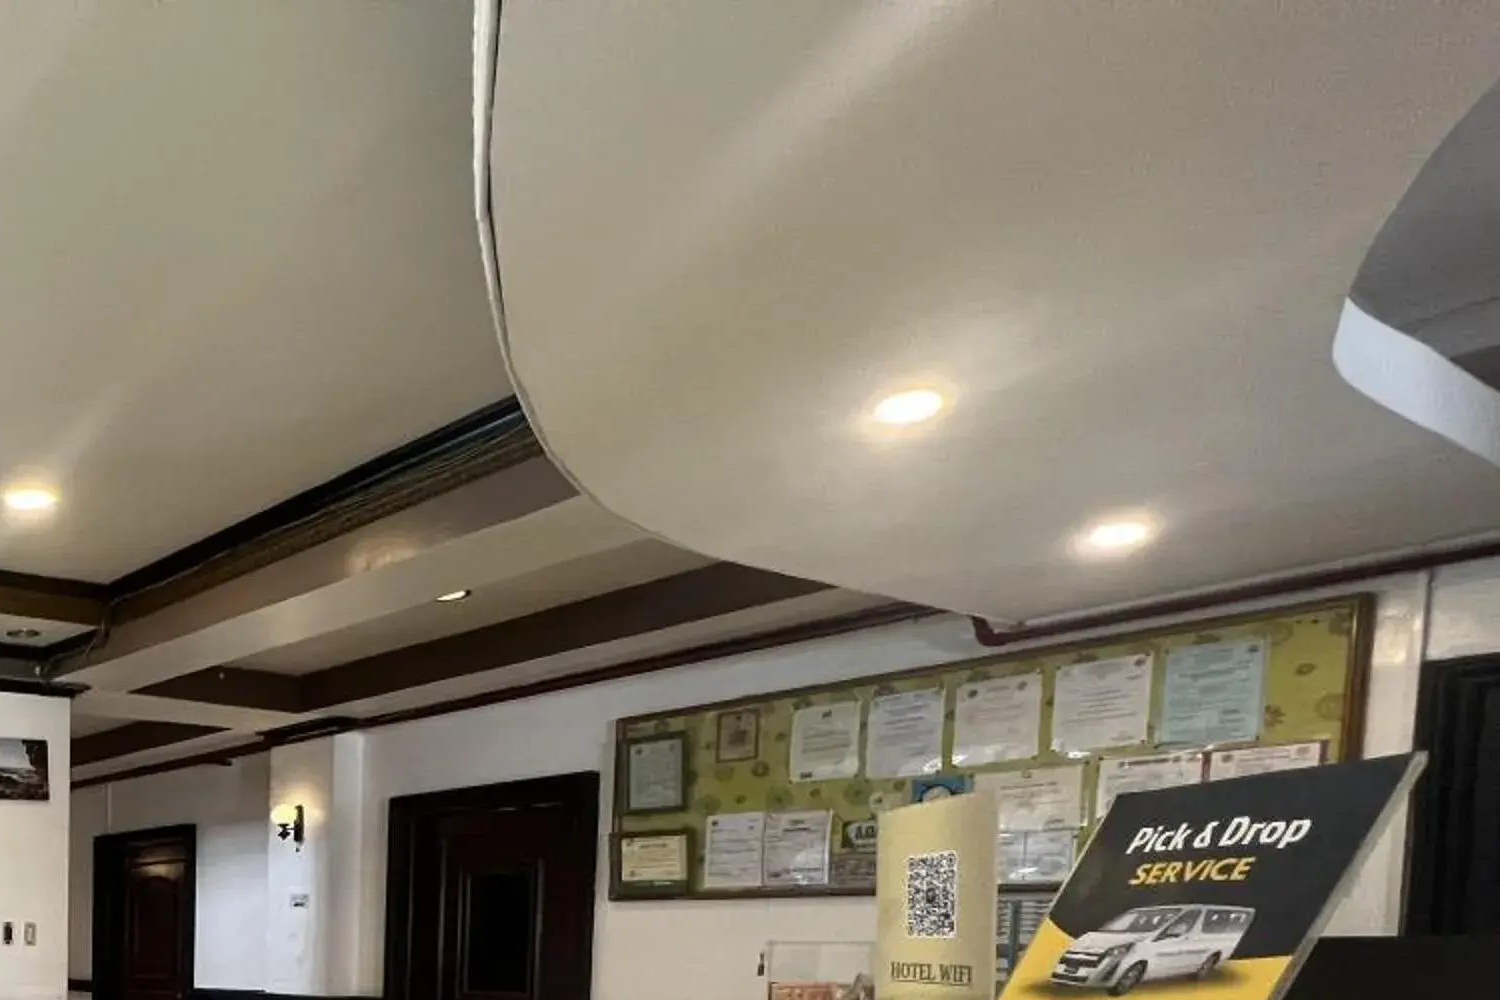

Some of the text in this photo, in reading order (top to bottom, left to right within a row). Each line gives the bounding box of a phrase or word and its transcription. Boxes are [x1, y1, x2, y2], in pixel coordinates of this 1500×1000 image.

[1125, 815, 1313, 855] Pick & Drop
[1127, 856, 1257, 885] SERVICE
[890, 961, 973, 984] HOTEL WIFI
